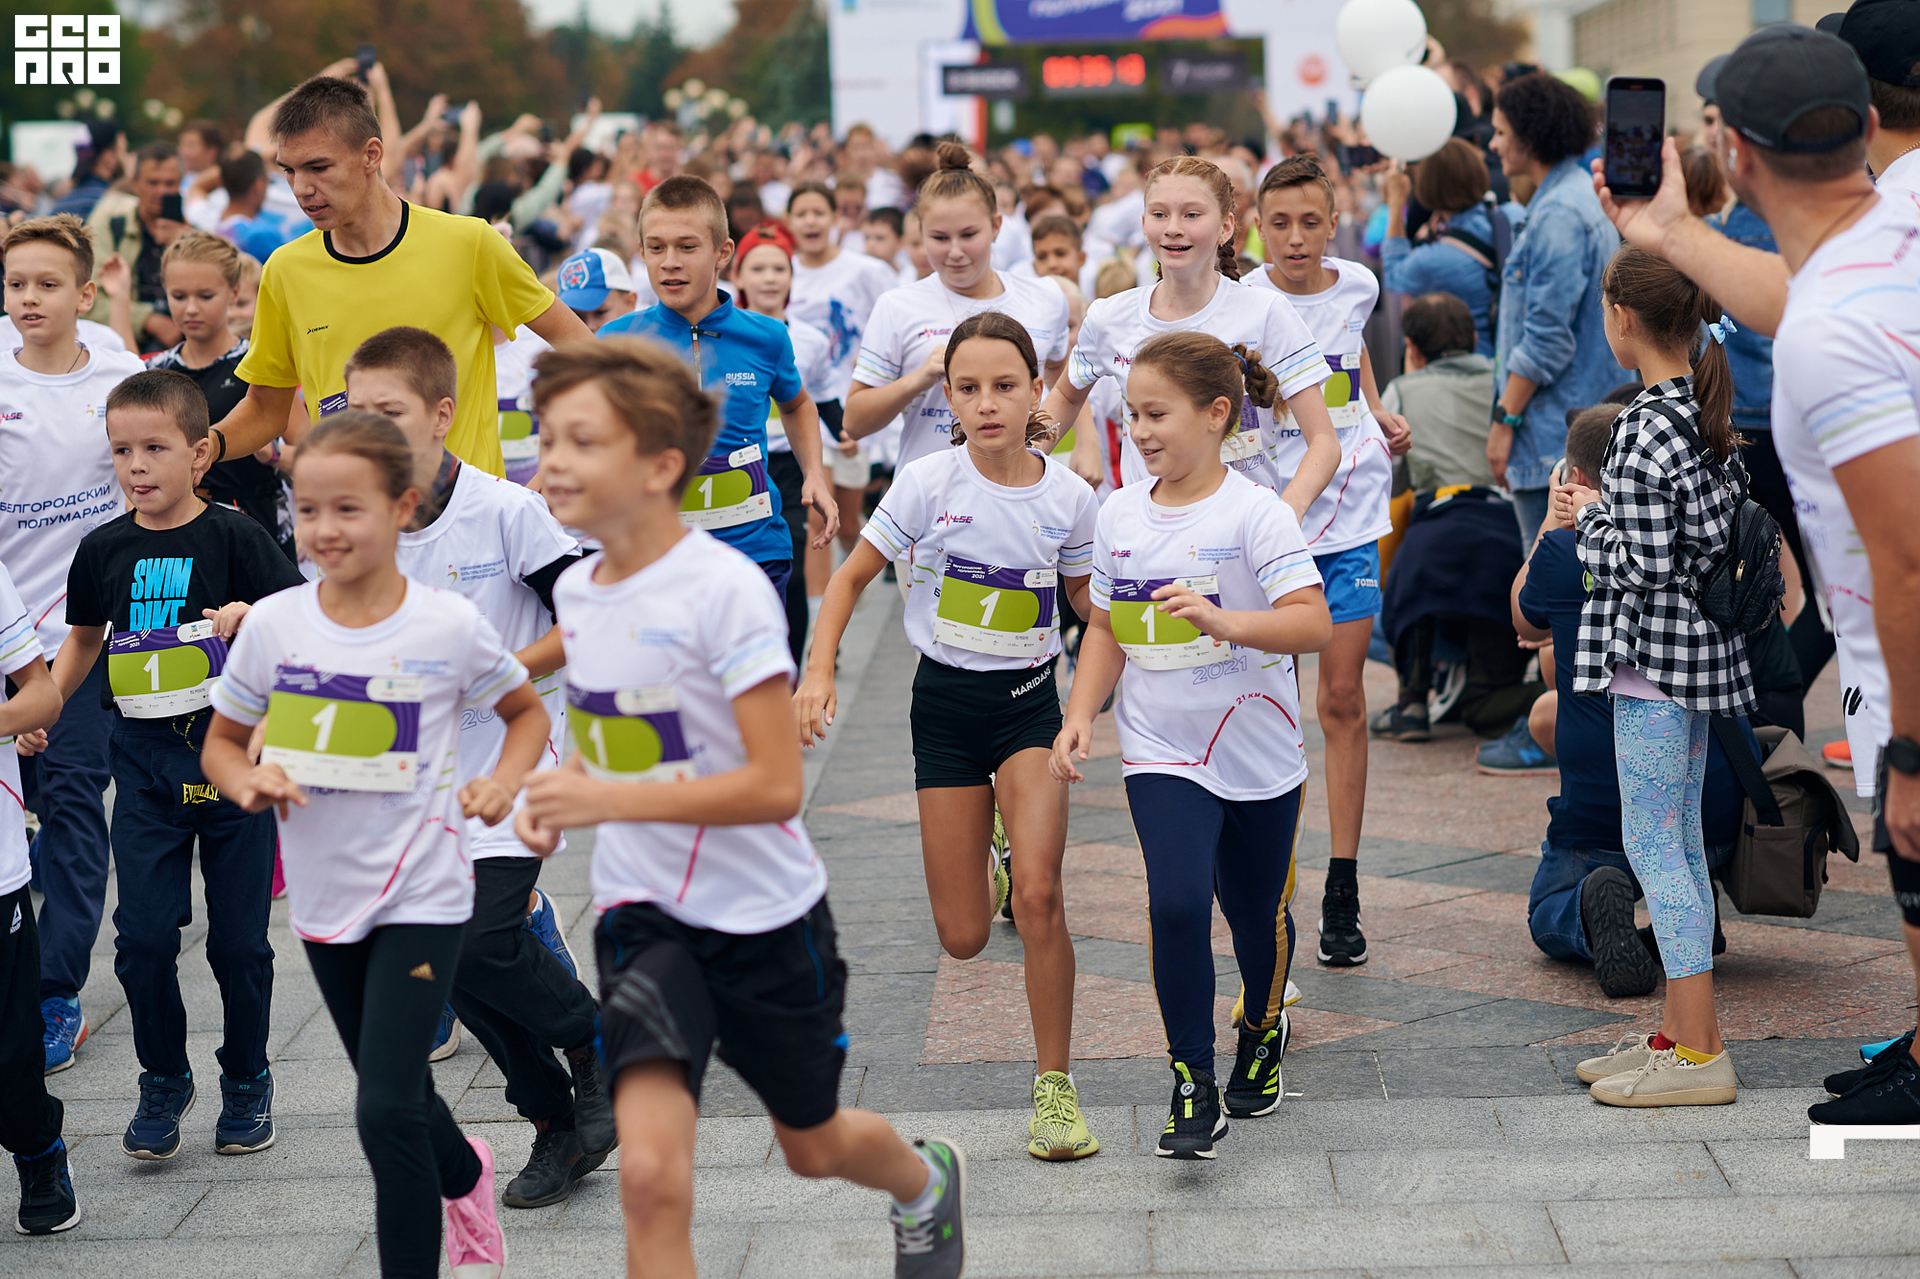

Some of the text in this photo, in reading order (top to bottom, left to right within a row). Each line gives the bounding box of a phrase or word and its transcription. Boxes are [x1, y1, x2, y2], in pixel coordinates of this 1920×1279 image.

[725, 372, 755, 384] RUSSIA
[0, 483, 110, 513] БЕЛГОРОДСКИЙ
[698, 477, 713, 508] 1
[18, 499, 118, 529] ПОЛУМАРАФОН
[131, 558, 193, 600] SWIM
[979, 590, 1000, 627] 1
[1140, 604, 1155, 643] 1
[143, 653, 160, 691] 1
[1192, 655, 1248, 685] 2021
[311, 702, 338, 752] 1
[588, 717, 609, 769] 1
[238, 1083, 251, 1091] KTF
